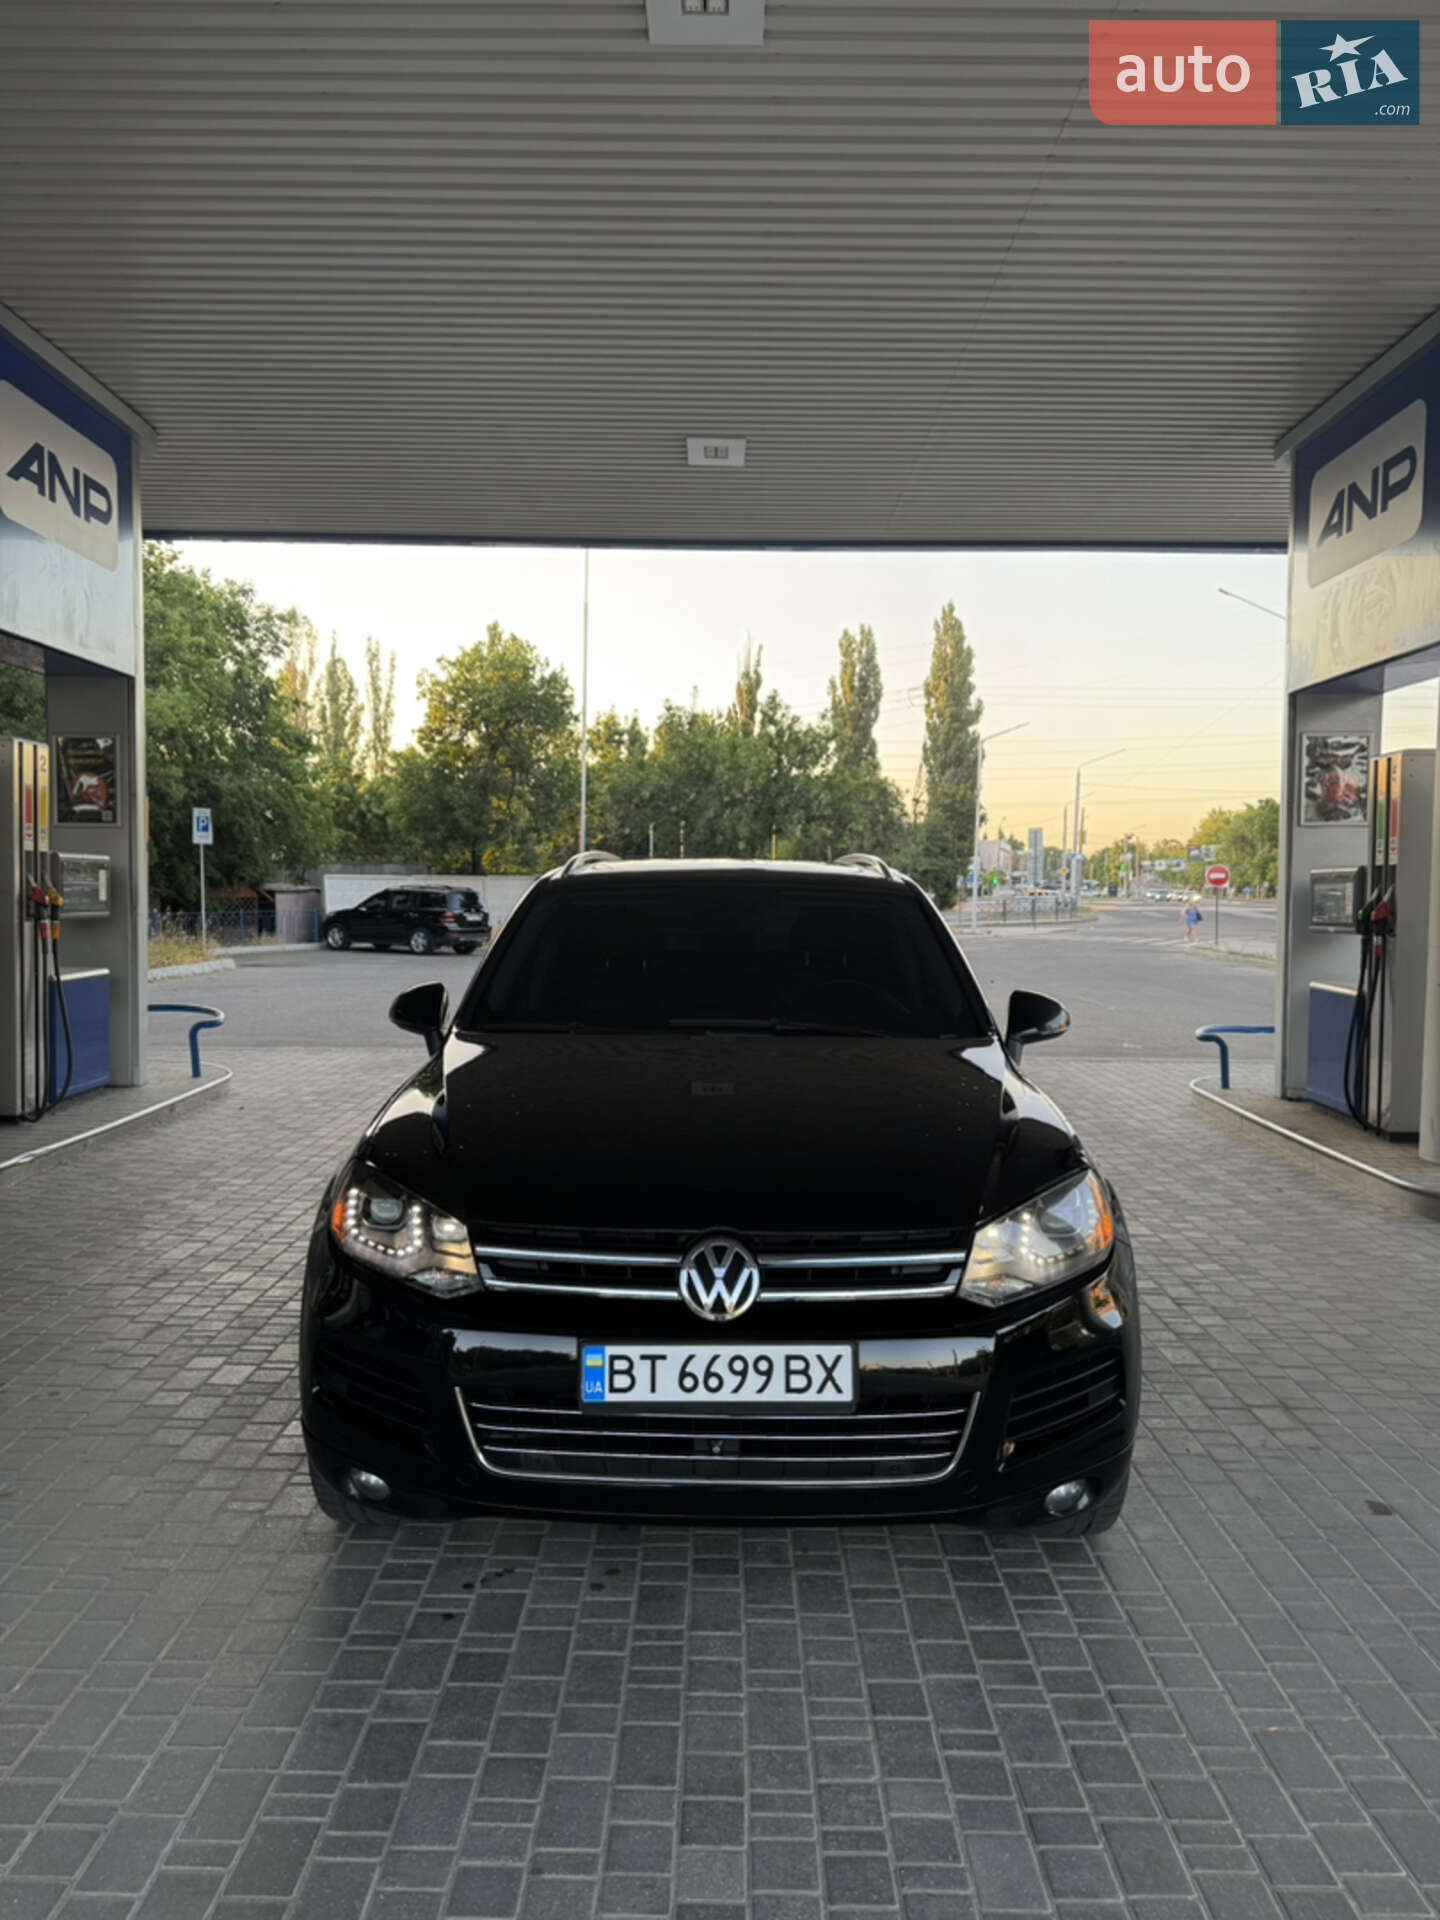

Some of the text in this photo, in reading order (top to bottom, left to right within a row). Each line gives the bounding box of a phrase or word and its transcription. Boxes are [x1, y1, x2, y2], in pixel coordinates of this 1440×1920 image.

[6, 442, 113, 526] ANP
[1317, 445, 1418, 548] ANP
[585, 1381, 604, 1394] UA
[608, 1353, 844, 1394] BT 6699 BX
